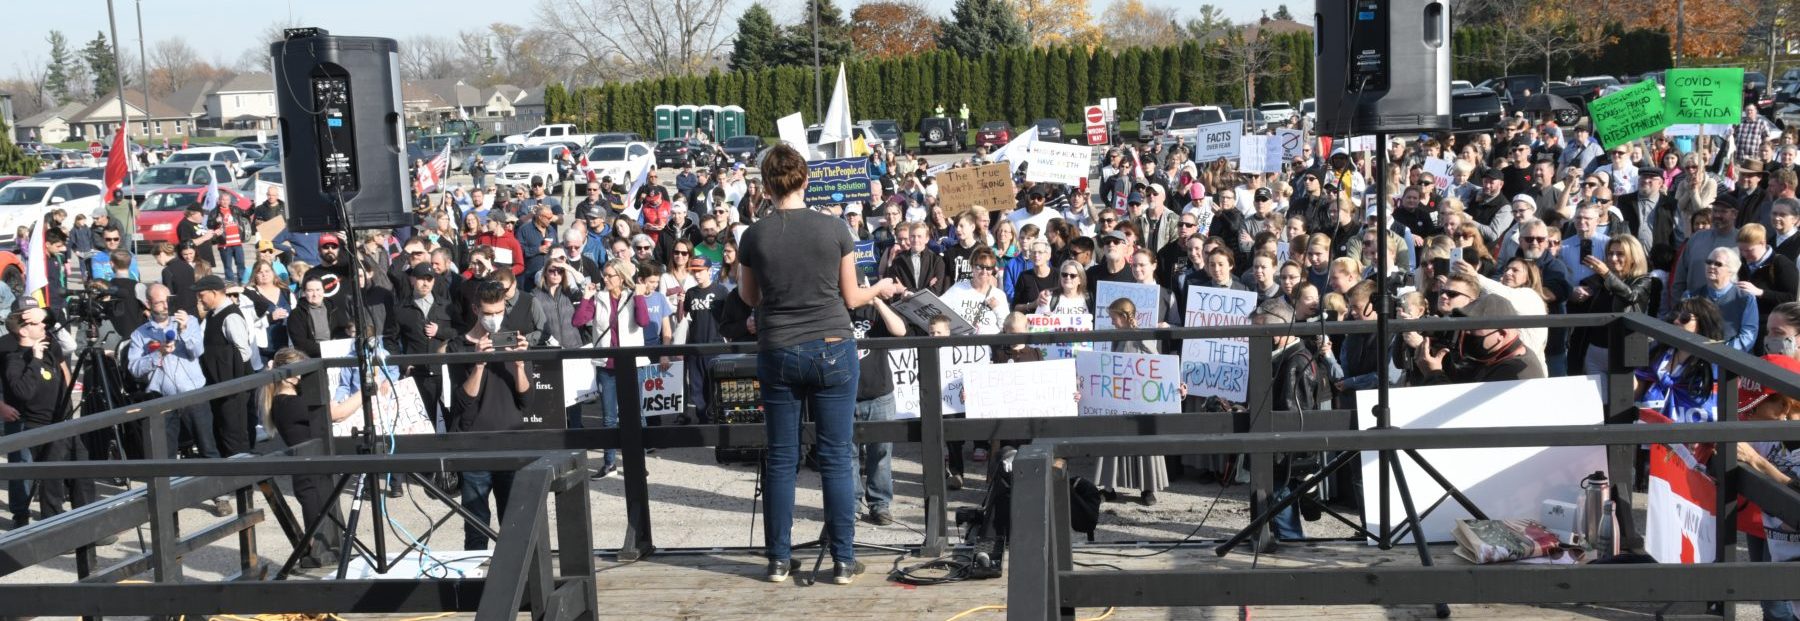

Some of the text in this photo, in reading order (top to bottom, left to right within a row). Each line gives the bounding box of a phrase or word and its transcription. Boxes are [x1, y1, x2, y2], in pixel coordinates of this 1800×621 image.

[1675, 77, 1711, 86] COVID
[1680, 97, 1712, 107] EVIL
[1676, 107, 1731, 118] AGENDA
[1207, 131, 1231, 143] FACTS
[945, 167, 1000, 181] The True
[808, 185, 823, 193] Join
[837, 182, 866, 191] Solution
[1196, 292, 1246, 315] YOUR
[1027, 317, 1082, 326] MEDIA IS
[952, 345, 985, 365] DID
[1205, 340, 1248, 366] THEIR
[1101, 353, 1162, 379] PEACE
[645, 378, 664, 391] OR
[1090, 374, 1175, 403] FREEOM
[530, 414, 543, 422] the
